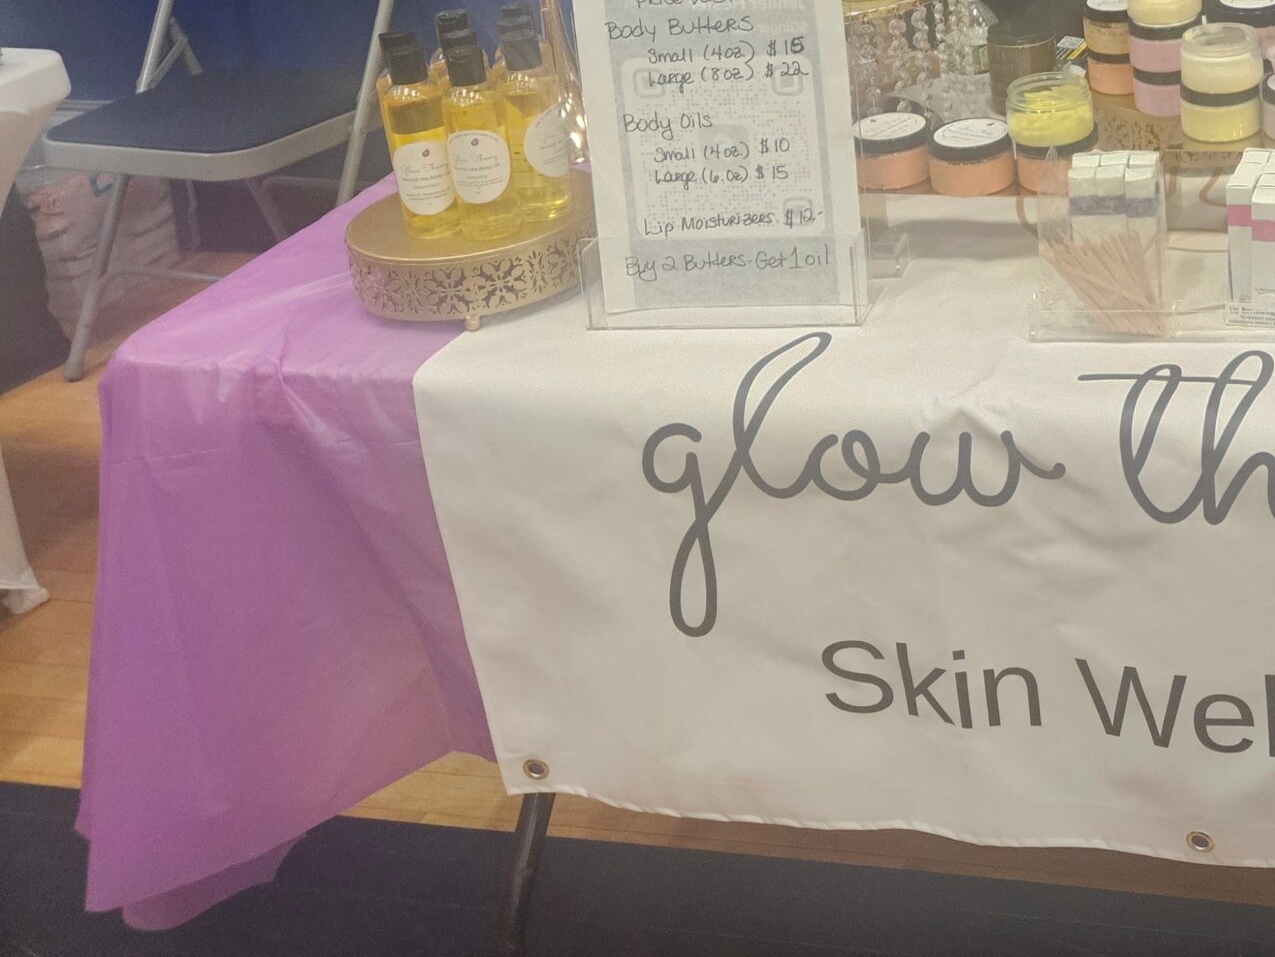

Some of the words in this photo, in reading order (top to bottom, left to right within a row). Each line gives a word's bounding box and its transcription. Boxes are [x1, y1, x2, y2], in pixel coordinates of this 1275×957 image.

[605, 18, 656, 42] Body
[648, 48, 693, 64] Small
[623, 112, 674, 140] Body
[680, 112, 714, 131] Oils
[654, 145, 696, 164] Small
[644, 218, 674, 238] Lip
[662, 256, 678, 271] 2
[642, 332, 1066, 637] glow
[822, 640, 1042, 729] Skin
